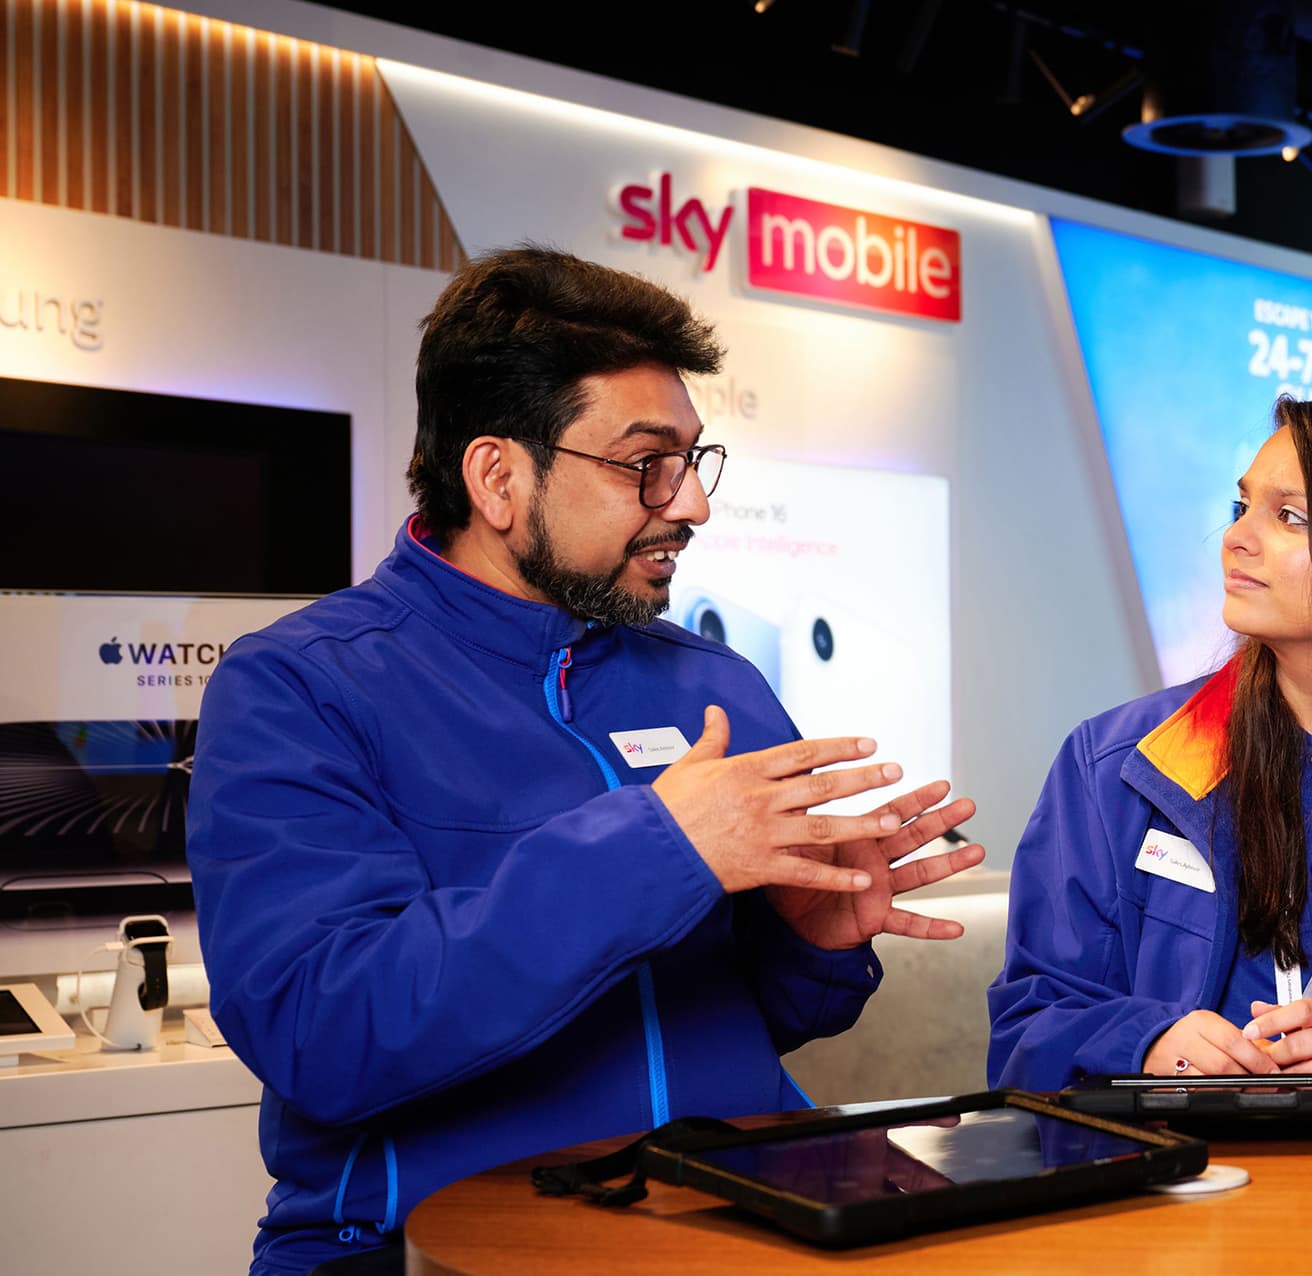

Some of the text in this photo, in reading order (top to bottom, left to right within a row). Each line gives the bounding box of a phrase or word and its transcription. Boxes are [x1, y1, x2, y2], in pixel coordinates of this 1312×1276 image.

[620, 172, 951, 299] sky mobile
[137, 675, 193, 687] SERIES
[623, 742, 644, 754] sky
[1145, 844, 1169, 861] sky
